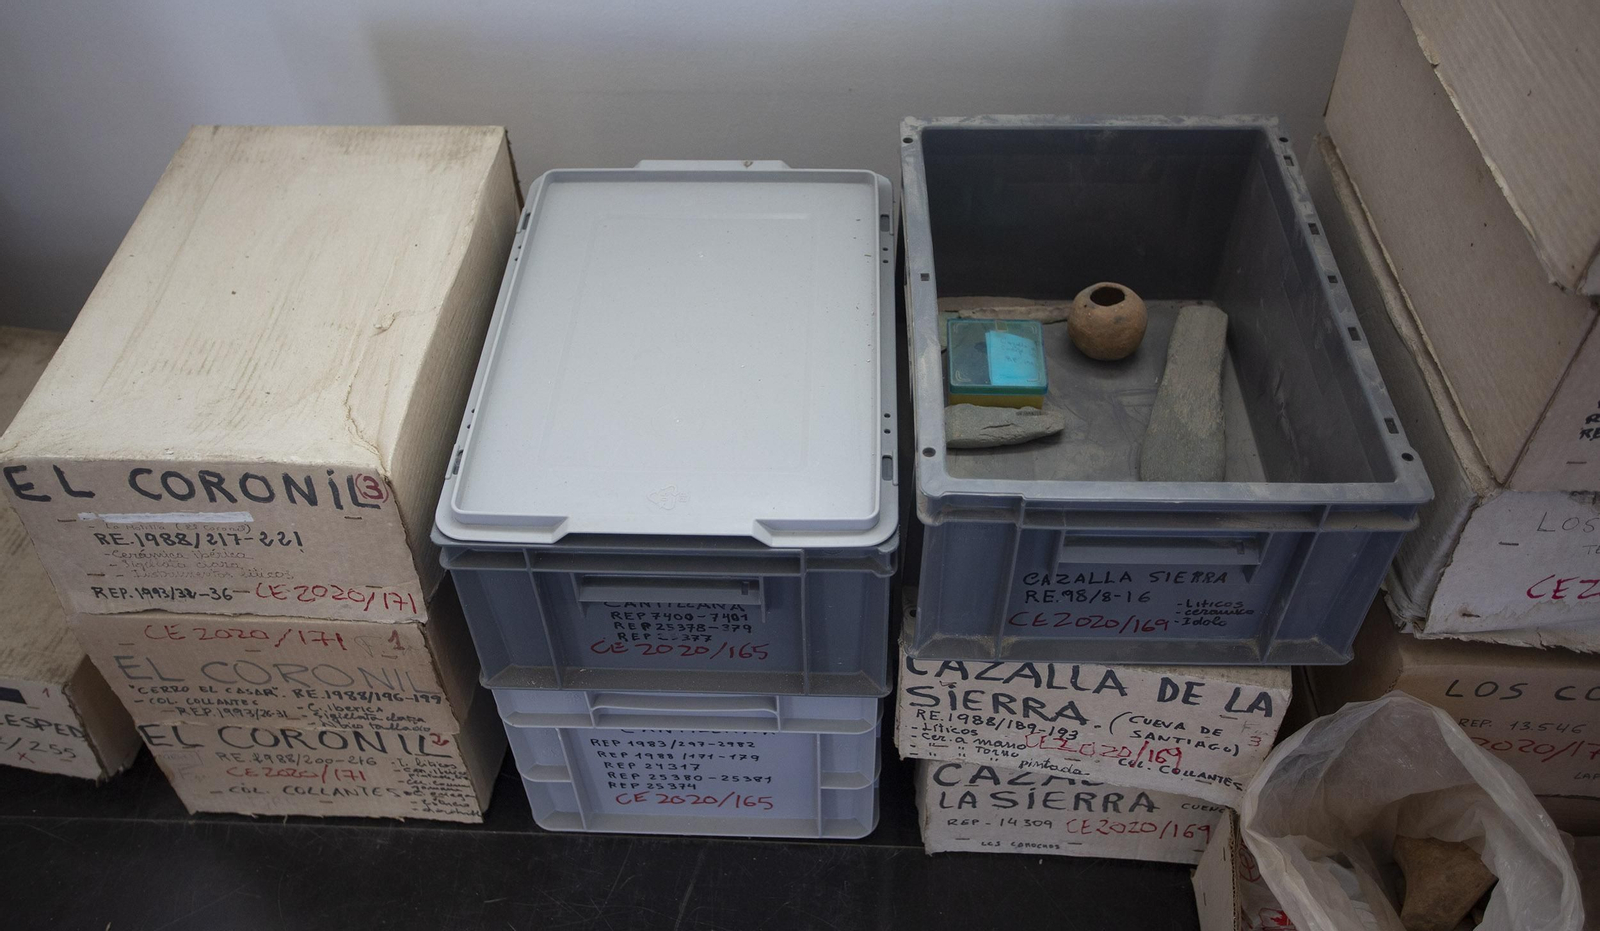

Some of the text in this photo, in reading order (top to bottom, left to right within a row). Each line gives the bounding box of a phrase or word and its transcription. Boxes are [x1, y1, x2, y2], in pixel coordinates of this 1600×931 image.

[3, 464, 96, 502] EL
[1537, 511, 1600, 534] LOS
[1023, 570, 1229, 587] CAZALLA SIERRA
[611, 611, 646, 621] REP
[614, 622, 651, 631] REP
[618, 632, 651, 642] REP
[113, 655, 443, 694] EL CORONIL
[199, 685, 219, 694] EL
[1445, 679, 1529, 700] LOS
[1157, 677, 1203, 706] DE
[1224, 687, 1273, 717] LA
[1200, 725, 1223, 737] DE
[138, 724, 205, 748] EL
[217, 725, 453, 759] CORONIL
[590, 738, 621, 747] REP
[597, 751, 629, 759] REP
[604, 761, 637, 770] REP
[607, 771, 641, 780] REP
[607, 781, 640, 789] REP
[282, 784, 402, 799] COLLANTES
[939, 789, 978, 810] LA
